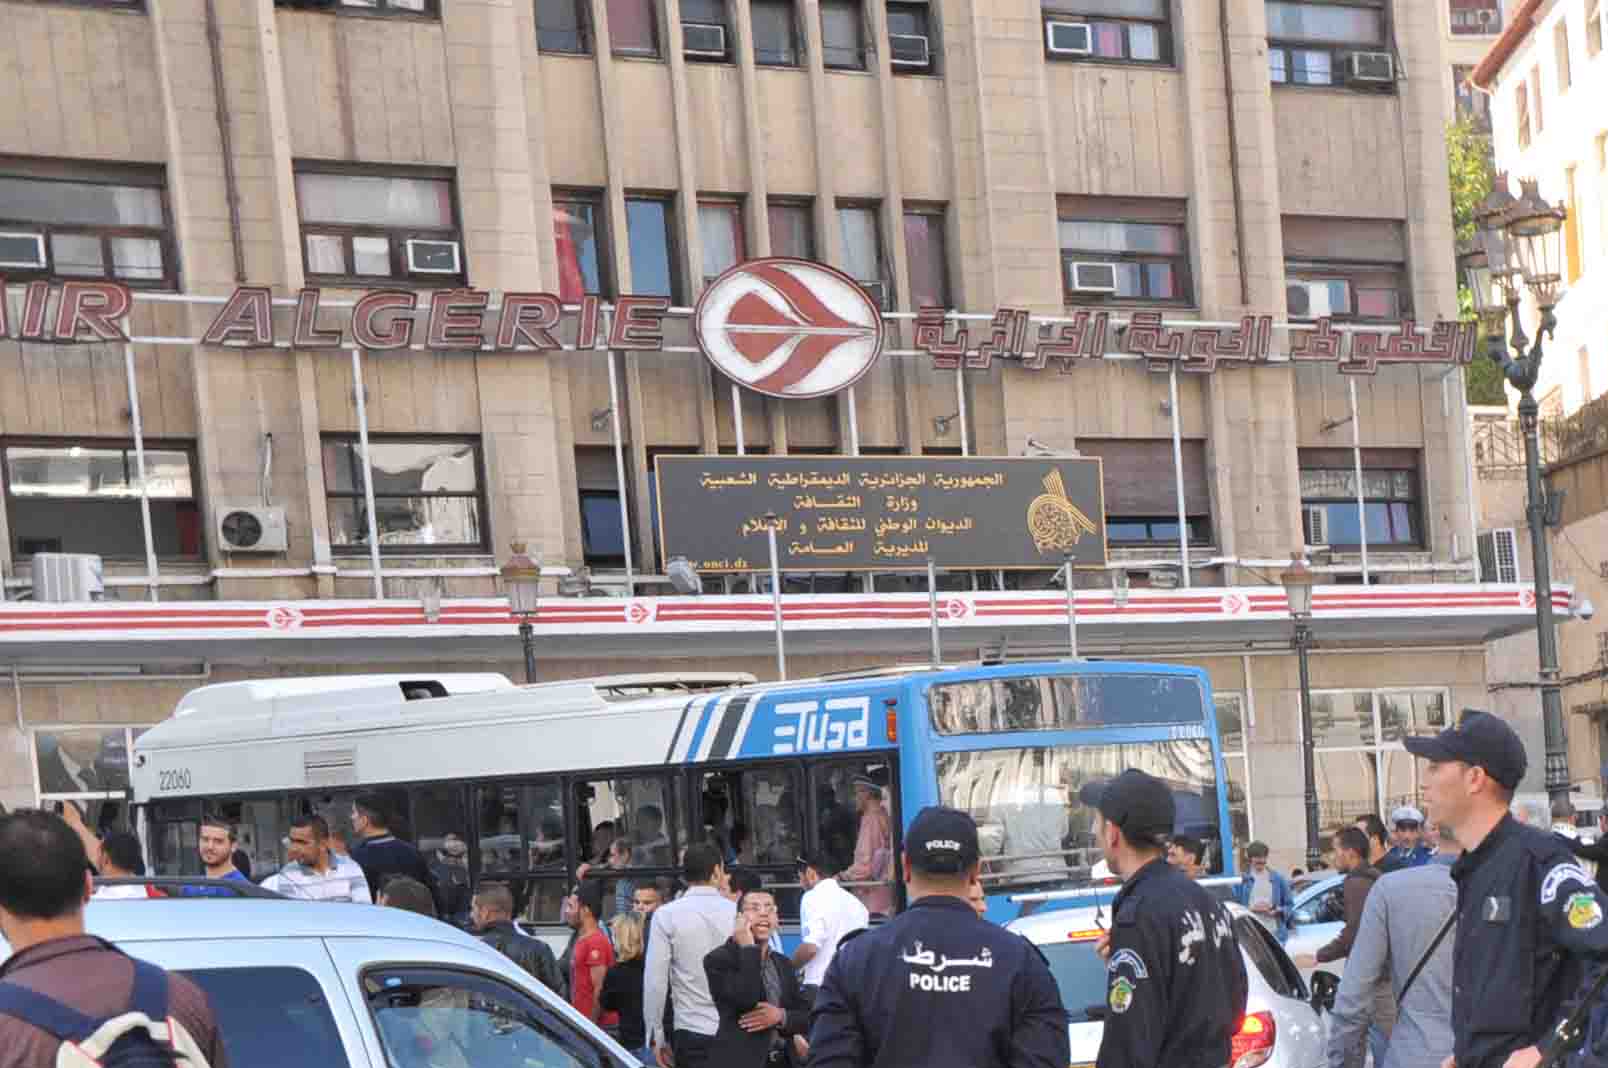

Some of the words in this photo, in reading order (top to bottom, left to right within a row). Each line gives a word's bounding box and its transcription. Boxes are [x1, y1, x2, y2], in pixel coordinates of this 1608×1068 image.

[0, 279, 131, 341] IR
[700, 471, 758, 489] الشعبية
[767, 471, 850, 489] الديمقراطية
[857, 471, 926, 490] الجزائرية
[932, 471, 1004, 490] الجمهورية
[885, 495, 919, 512] وزارة
[159, 768, 192, 791] 22060
[925, 839, 961, 851] POLICE
[909, 973, 971, 993] POLICE
